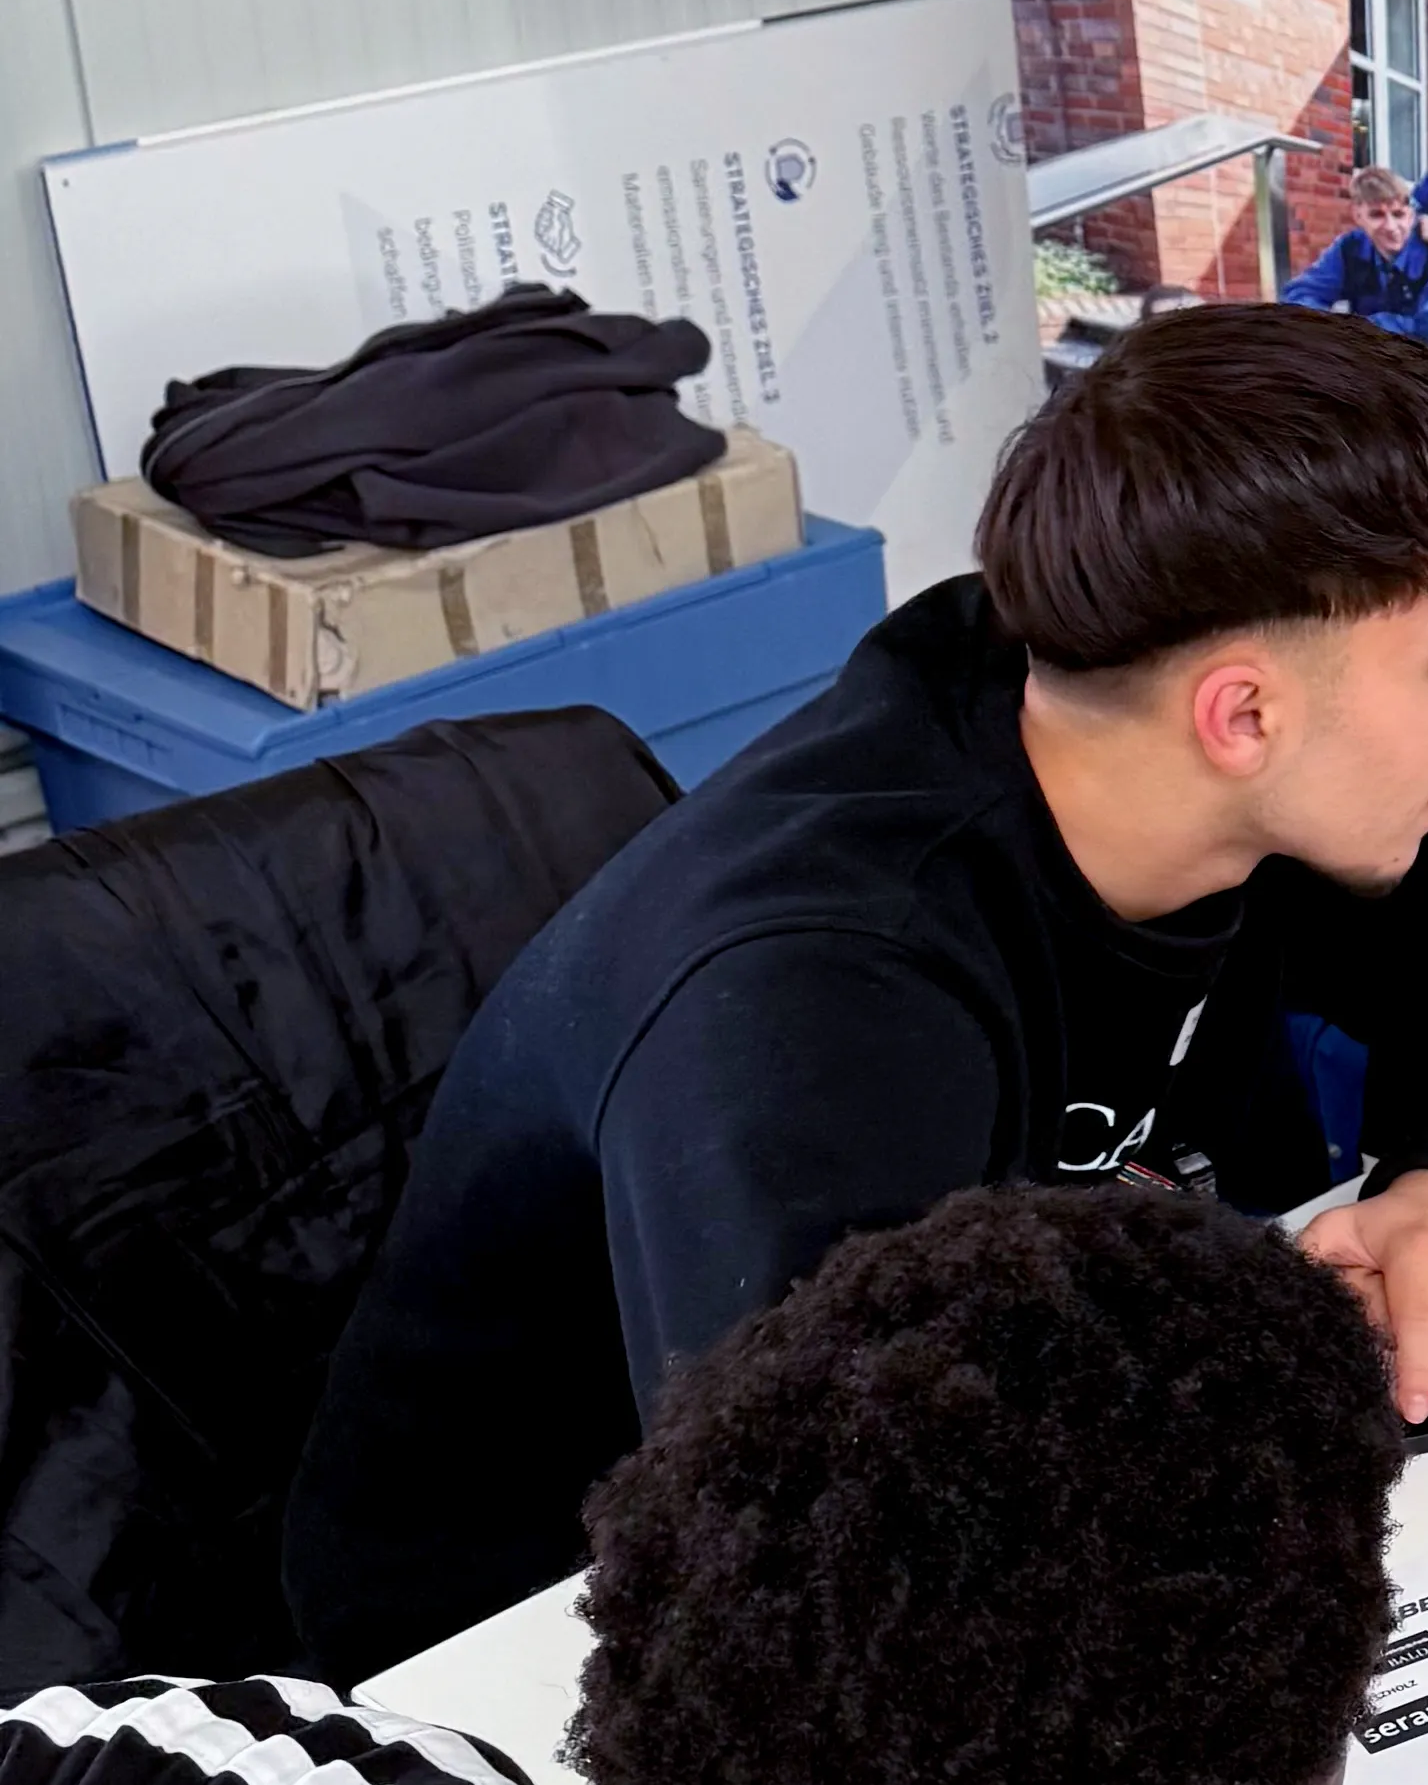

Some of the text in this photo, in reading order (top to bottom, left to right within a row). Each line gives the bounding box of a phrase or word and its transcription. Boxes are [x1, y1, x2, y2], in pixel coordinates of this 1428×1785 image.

[722, 149, 767, 334] STRATEGISCHES
[752, 336, 777, 388] ZIEL
[878, 257, 899, 297] und
[949, 104, 990, 278] STRATEGISCHES
[974, 282, 996, 325] ZIEL
[711, 286, 732, 326] und
